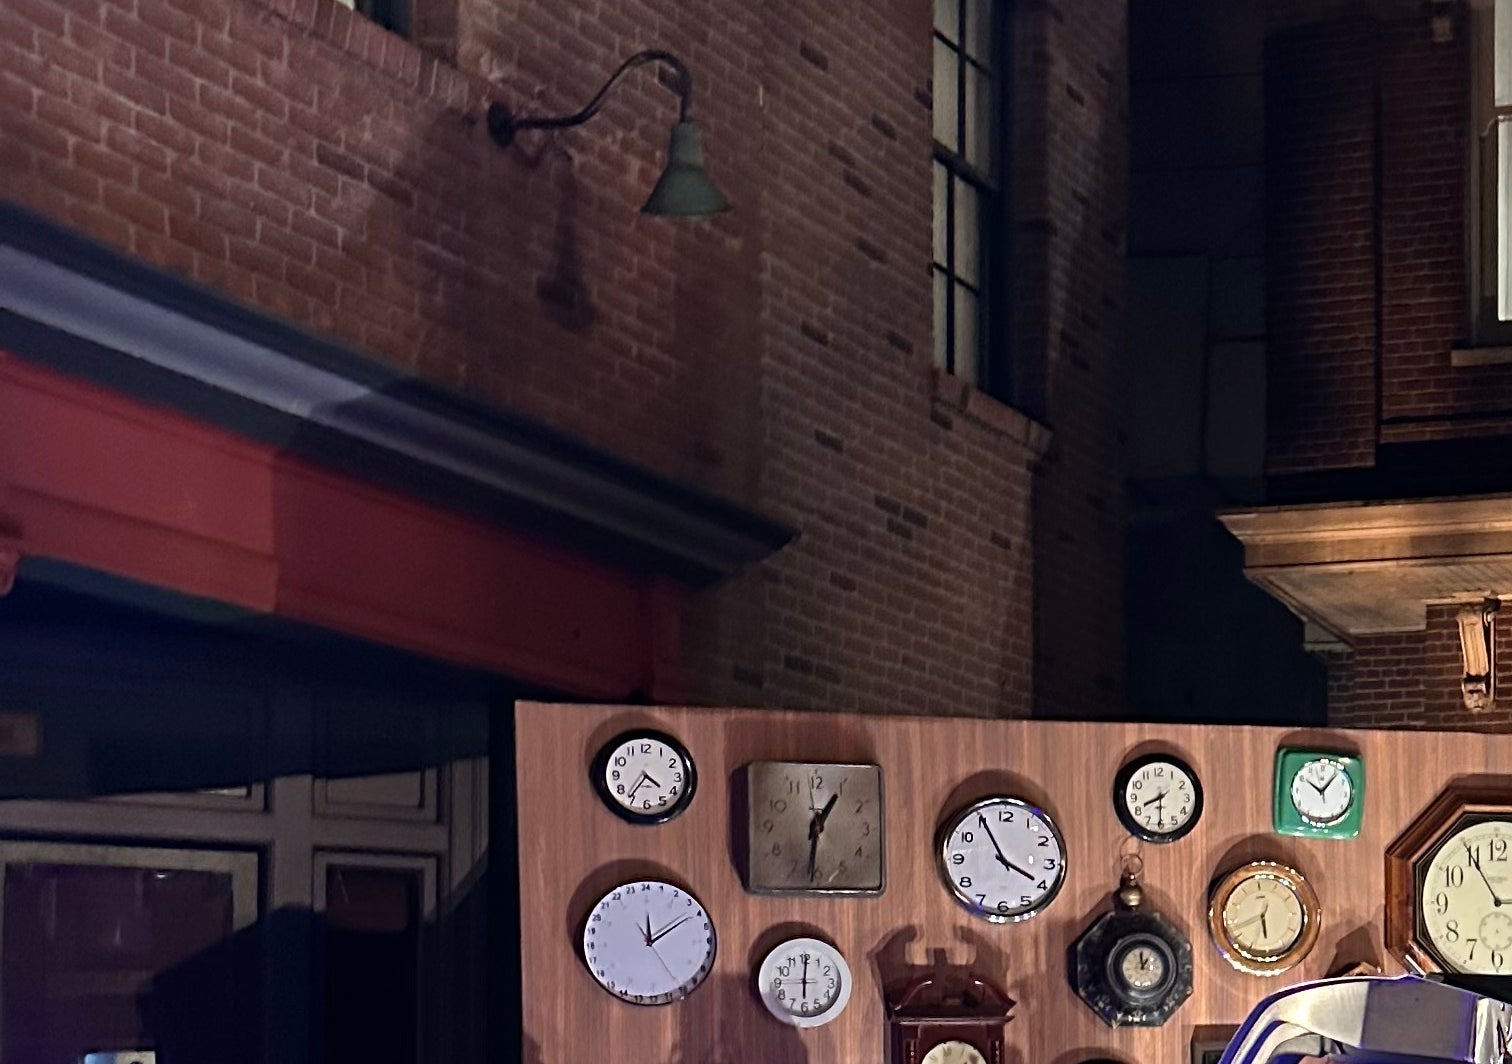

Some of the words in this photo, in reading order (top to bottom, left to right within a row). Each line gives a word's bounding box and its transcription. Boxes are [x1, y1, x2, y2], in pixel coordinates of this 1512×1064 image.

[627, 746, 634, 757] 11
[640, 743, 652, 754] 12
[614, 756, 627, 767] 10
[668, 758, 677, 769] 2
[612, 770, 620, 780] 9
[673, 772, 682, 783] 3
[1142, 770, 1149, 780] 11
[1154, 767, 1164, 777] 12
[616, 784, 625, 795] 8
[1132, 780, 1143, 790] 10
[1178, 780, 1186, 790] 2
[669, 786, 677, 796] 4
[658, 795, 667, 806] 5
[1130, 793, 1137, 803] 9
[643, 799, 651, 810] 6
[998, 811, 1014, 822] 12
[1134, 806, 1142, 816] 8
[1180, 806, 1187, 816] 4
[1144, 816, 1151, 826] 7
[1171, 816, 1178, 826] 5
[961, 831, 974, 843] 10
[1037, 836, 1049, 847] 2
[1468, 844, 1480, 867] 11
[1488, 839, 1507, 862] 12
[952, 853, 965, 865] 9
[1043, 858, 1056, 870] 3
[959, 876, 972, 888] 8
[1445, 865, 1464, 888] 10
[1036, 879, 1048, 891] 4
[975, 893, 986, 905] 7
[1020, 896, 1032, 906] 5
[1436, 891, 1448, 915] 9
[997, 901, 1009, 913] 6
[1446, 919, 1459, 943] 8
[1466, 938, 1477, 961] 7
[787, 957, 796, 968] 11
[1491, 948, 1504, 969] 6
[776, 965, 790, 977] 10
[822, 965, 831, 977] 2
[773, 977, 782, 988] 9
[827, 978, 835, 989] 3
[777, 988, 786, 1000] 8
[823, 989, 830, 1001] 4
[789, 998, 796, 1009] 7
[800, 1002, 809, 1014] 6
[813, 998, 822, 1009] 5
